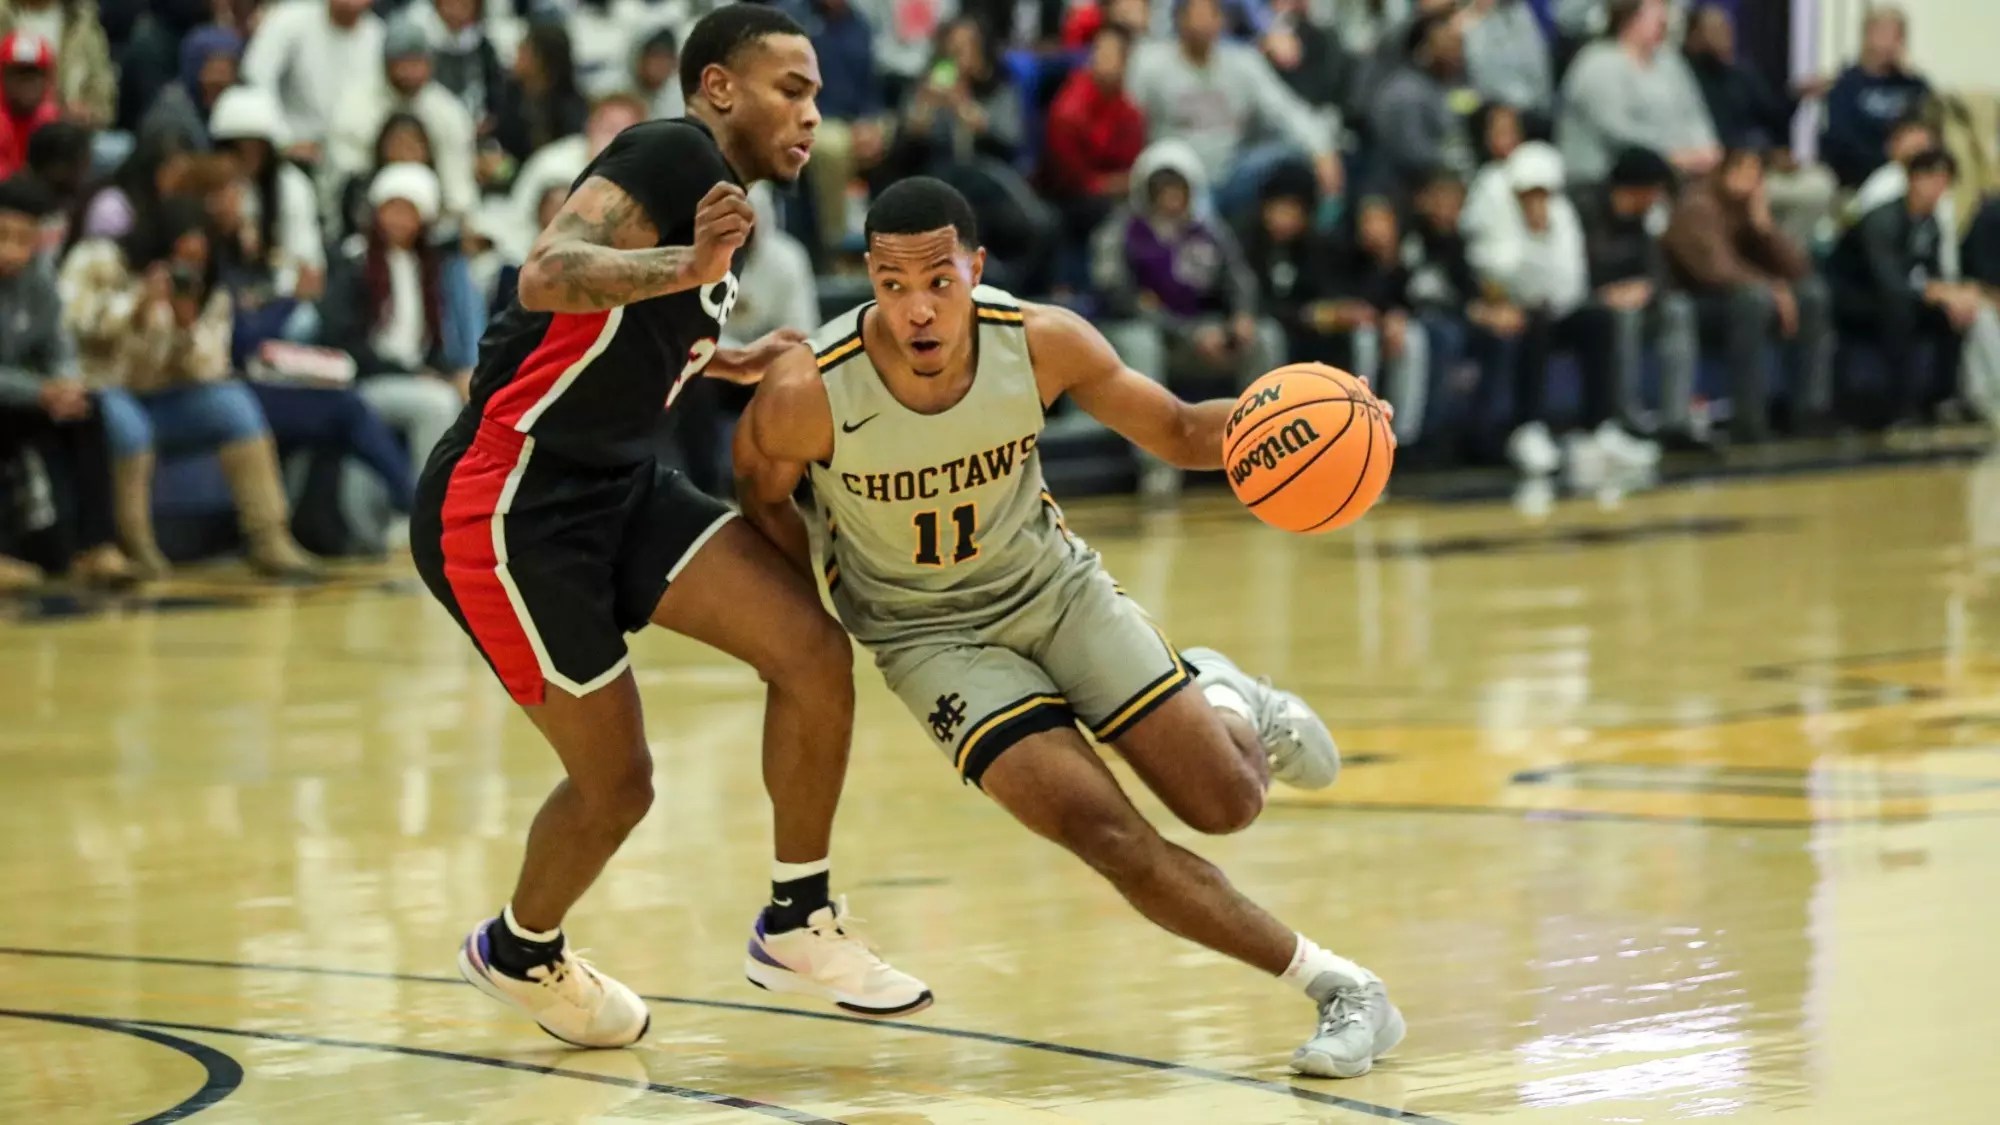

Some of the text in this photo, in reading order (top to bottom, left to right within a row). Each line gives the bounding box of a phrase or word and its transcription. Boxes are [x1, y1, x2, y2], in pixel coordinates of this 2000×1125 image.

[841, 434, 1037, 503] CHOCTAWS
[1231, 419, 1320, 487] Wilson
[912, 501, 981, 568] 11
